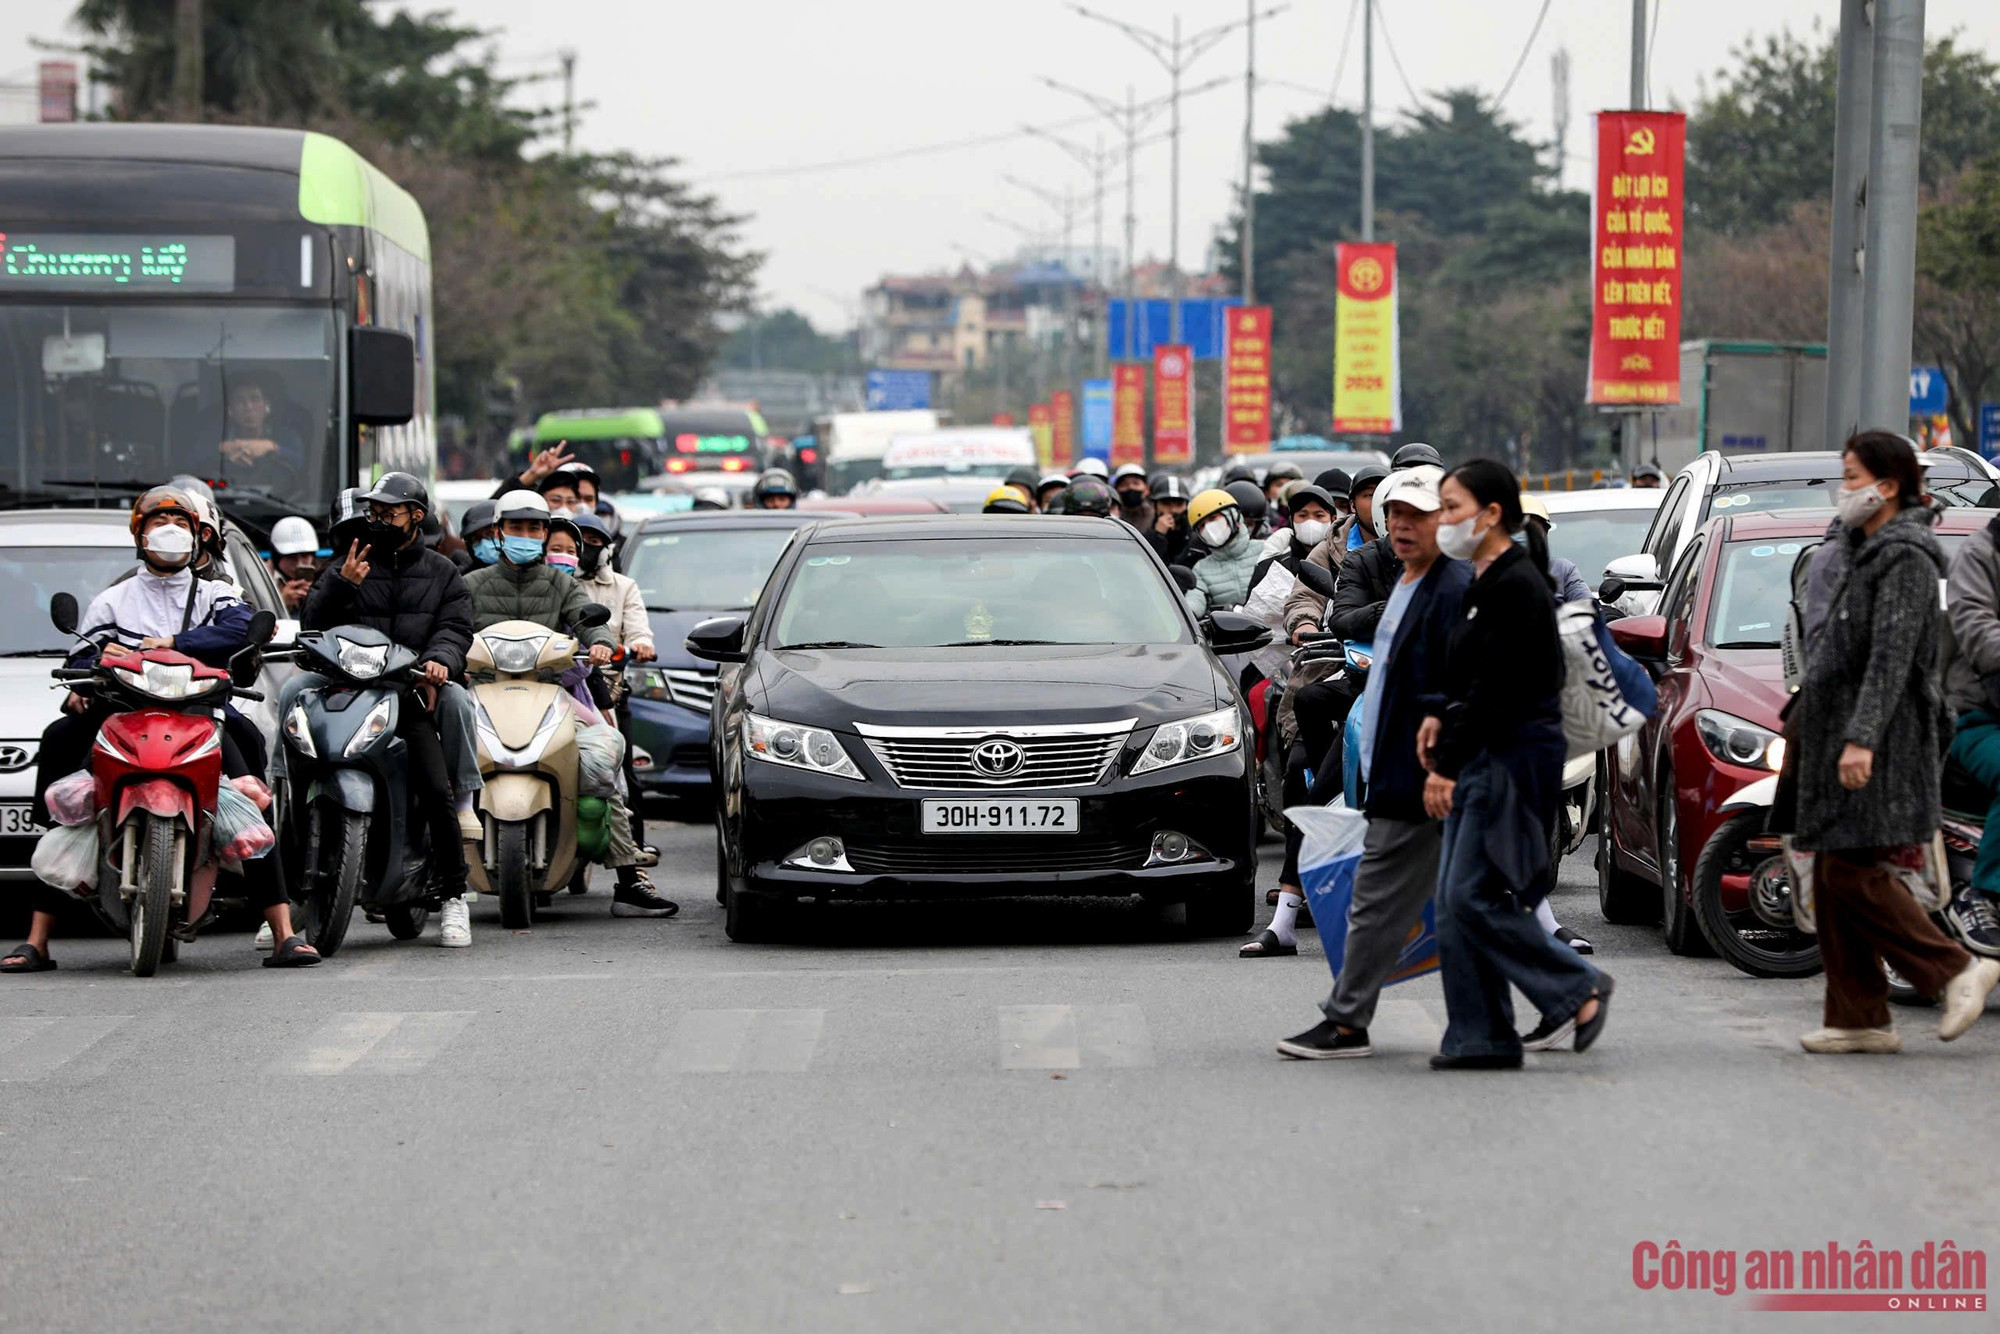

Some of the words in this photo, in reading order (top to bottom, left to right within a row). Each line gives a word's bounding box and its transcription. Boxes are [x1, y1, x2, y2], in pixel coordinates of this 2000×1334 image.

[1606, 204, 1627, 233] CỦA
[1602, 239, 1622, 268] CỦA
[1625, 242, 1653, 268] NHÂN
[1626, 277, 1651, 304] TRÊN
[936, 806, 1066, 827] 30H-911.72
